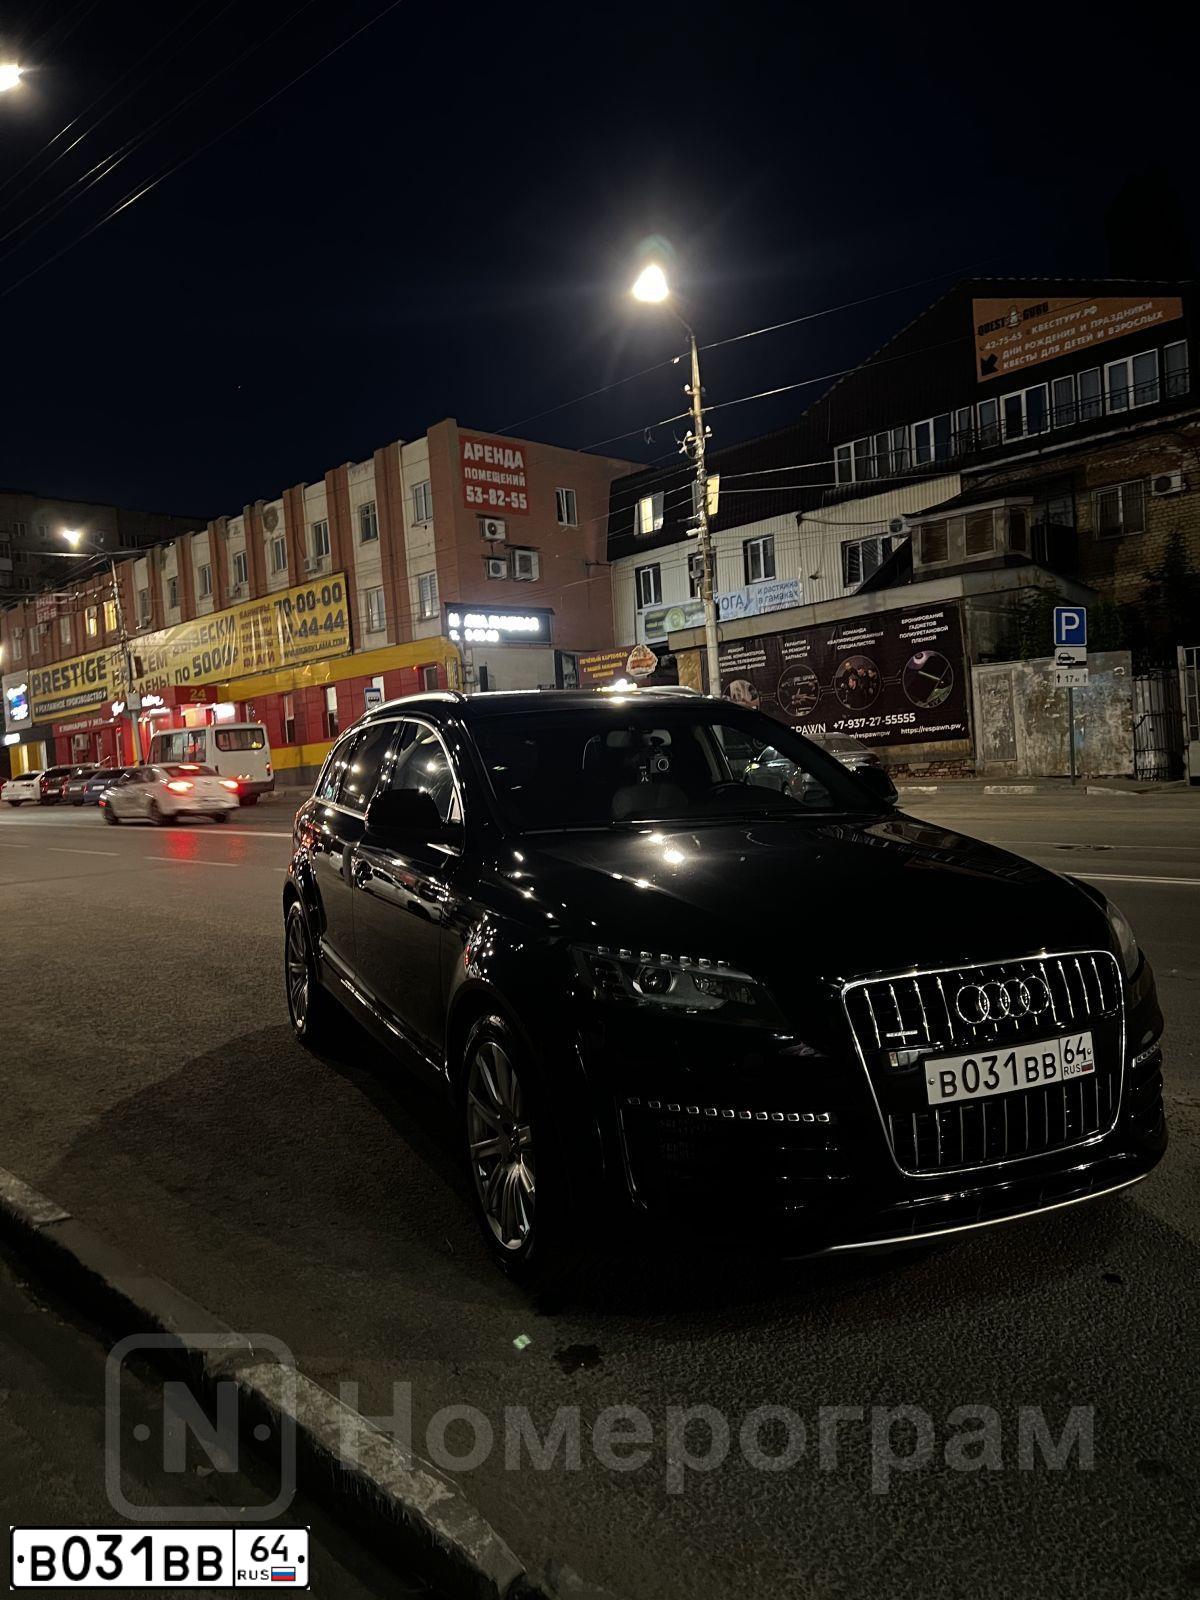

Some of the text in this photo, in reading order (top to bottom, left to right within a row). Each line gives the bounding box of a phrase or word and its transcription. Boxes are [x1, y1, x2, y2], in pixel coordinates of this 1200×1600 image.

[1002, 301, 1153, 360] ДНИ РОЖДЕНИЯ И ПРАЗДНИКИ
[1003, 310, 1163, 370] КВЕСТЫ ДЛЯ ДЕТЕЙ И ВЗРОСЛЫХ
[464, 441, 524, 470] АРЕНДА
[464, 467, 526, 487] ПОМЕЩЕНИЙ
[466, 485, 528, 510] 53-82-55
[274, 582, 343, 617] 70-00-00
[765, 590, 800, 604] гамаках
[901, 611, 944, 625] БРОНИРОВАНИЕ
[908, 620, 937, 631] ГАДЖЕТОВ
[1061, 612, 1080, 641] P
[899, 624, 949, 639] ПОЛИУРЕТАНОВОЙ
[31, 655, 108, 697] PRESTIGE
[174, 666, 190, 685] ПО
[1065, 675, 1074, 683] 17
[190, 689, 207, 699] 24
[833, 712, 917, 730] +7-937-27-55555
[1063, 1036, 1086, 1064] 64
[939, 1052, 1056, 1098] В031ВВ
[1063, 1064, 1081, 1076] RUS
